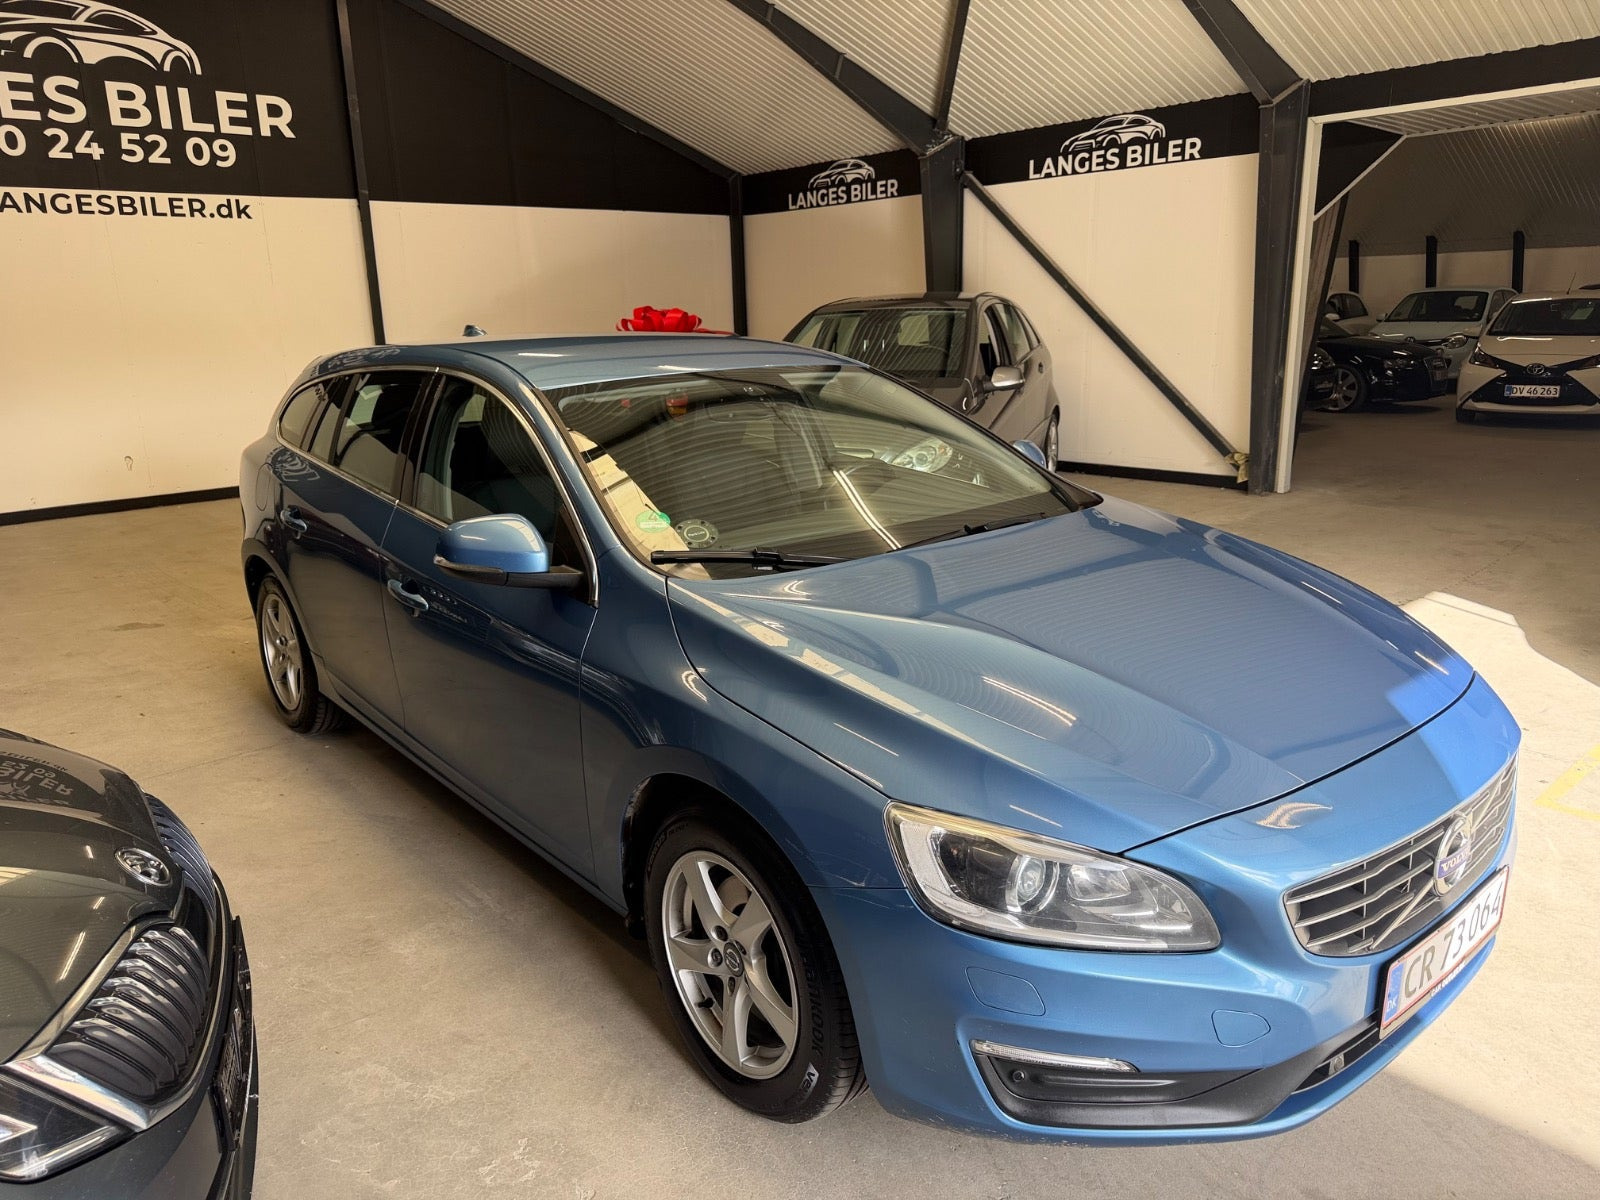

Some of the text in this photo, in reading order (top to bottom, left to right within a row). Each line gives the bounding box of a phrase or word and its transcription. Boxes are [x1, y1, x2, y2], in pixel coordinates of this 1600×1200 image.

[104, 80, 296, 139] BILER
[0, 124, 237, 168] 0 24 52 09
[1029, 137, 1202, 179] LANGES BILER
[0, 191, 253, 220] ANGESBILER.dk
[788, 179, 898, 210] LANGES BILER
[1511, 386, 1525, 395] DV
[1526, 387, 1538, 395] 46
[1540, 387, 1558, 396] 263
[1404, 945, 1436, 999] CR
[1440, 918, 1466, 971] 73
[1468, 880, 1503, 941] 064
[1386, 999, 1397, 1013] DK
